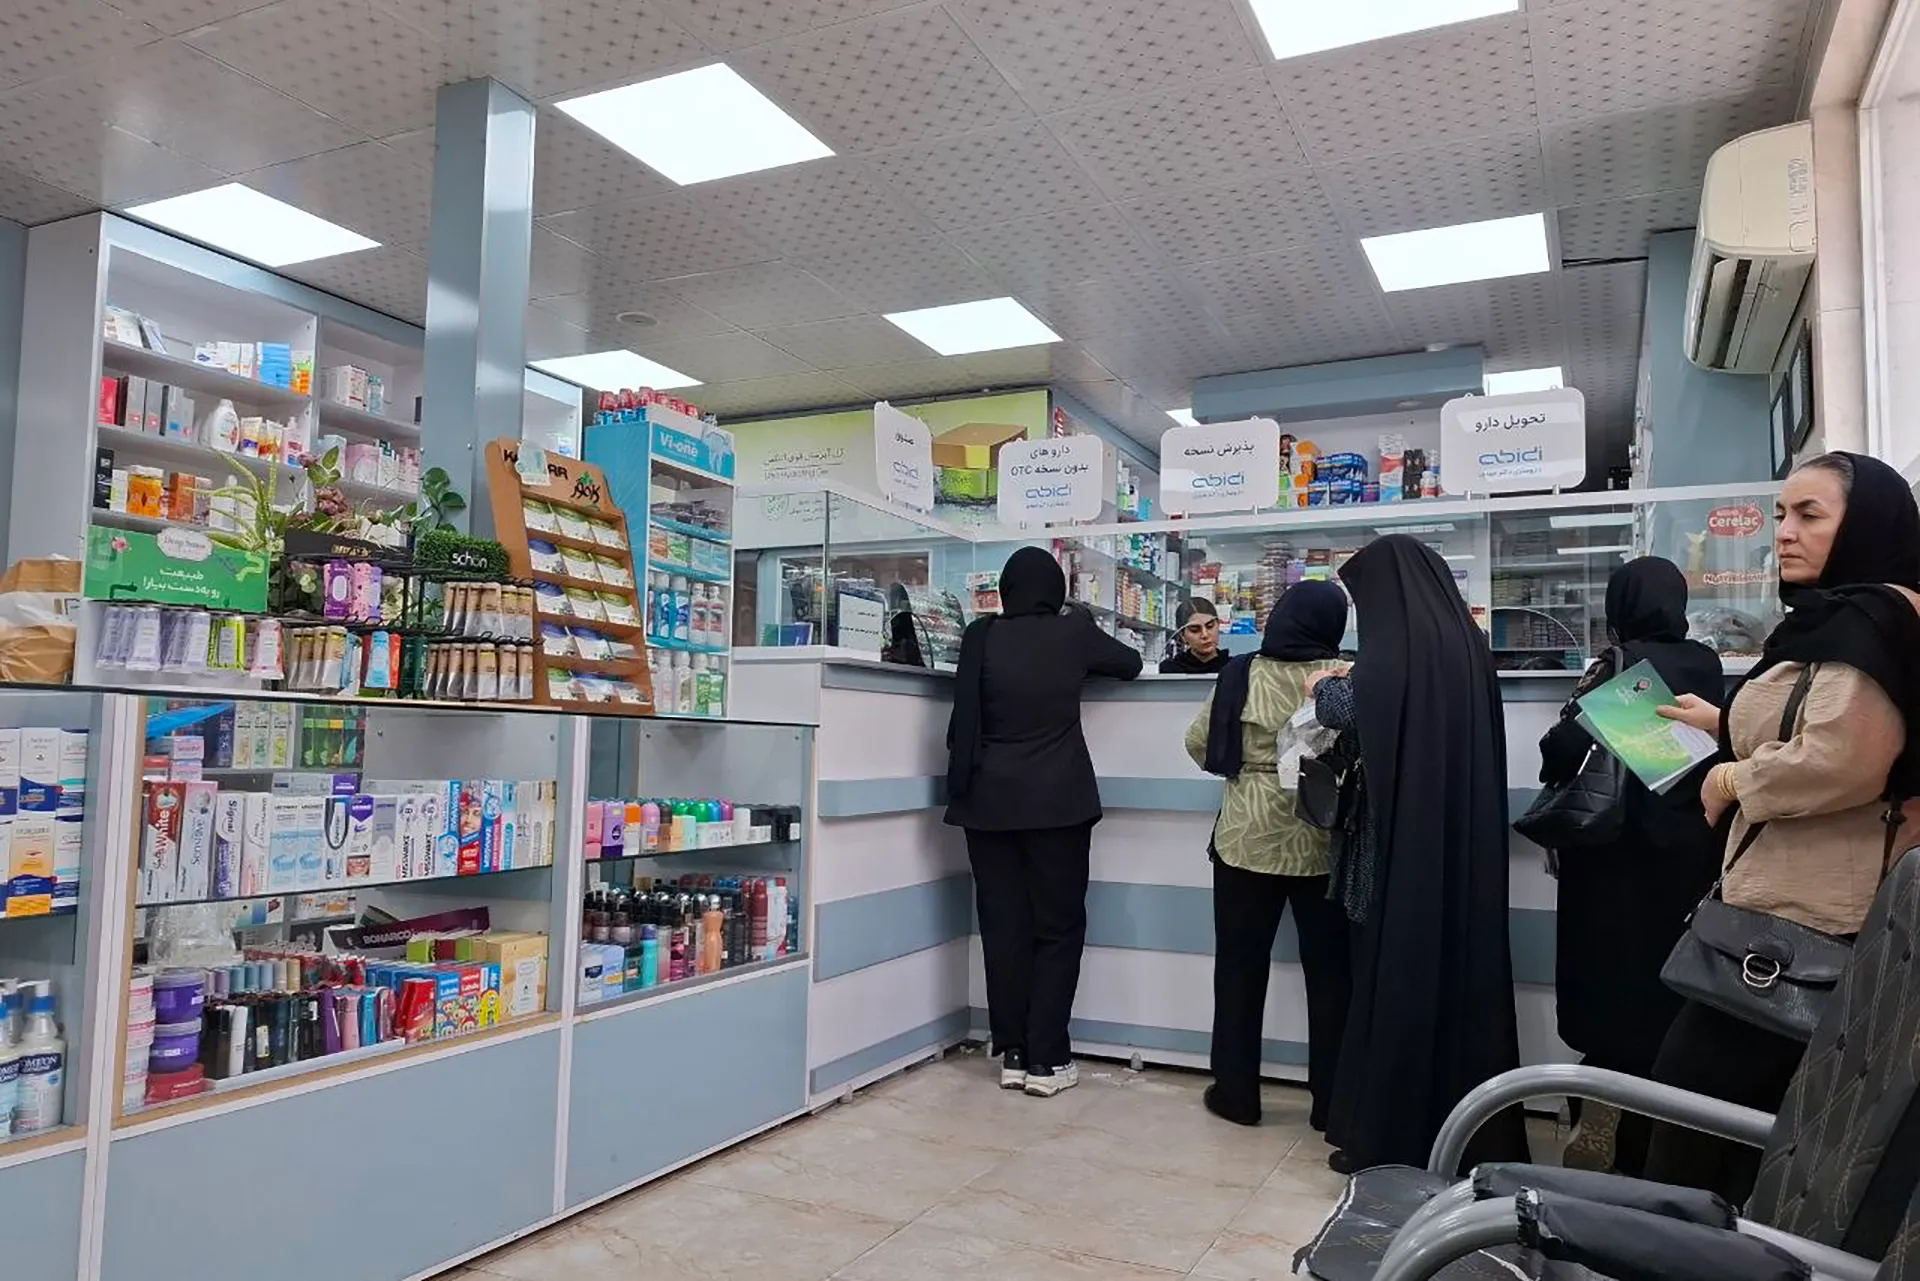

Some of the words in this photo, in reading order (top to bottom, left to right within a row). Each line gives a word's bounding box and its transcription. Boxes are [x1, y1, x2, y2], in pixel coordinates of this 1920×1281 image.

[1475, 416, 1499, 433] دارو
[1503, 412, 1546, 430] تحویل
[659, 432, 699, 457] Vi-one
[1183, 445, 1214, 457] نسخه
[1216, 440, 1255, 457] پذیرش
[1478, 446, 1542, 465] abidi
[1011, 465, 1032, 476] OTC
[1034, 464, 1061, 474] نسخه
[1063, 463, 1089, 475] بدون
[1192, 471, 1245, 488] abidi
[1025, 483, 1072, 499] abidi
[1708, 515, 1759, 528] Cerelac
[160, 566, 204, 581] طبیعت
[225, 800, 238, 833] Signal
